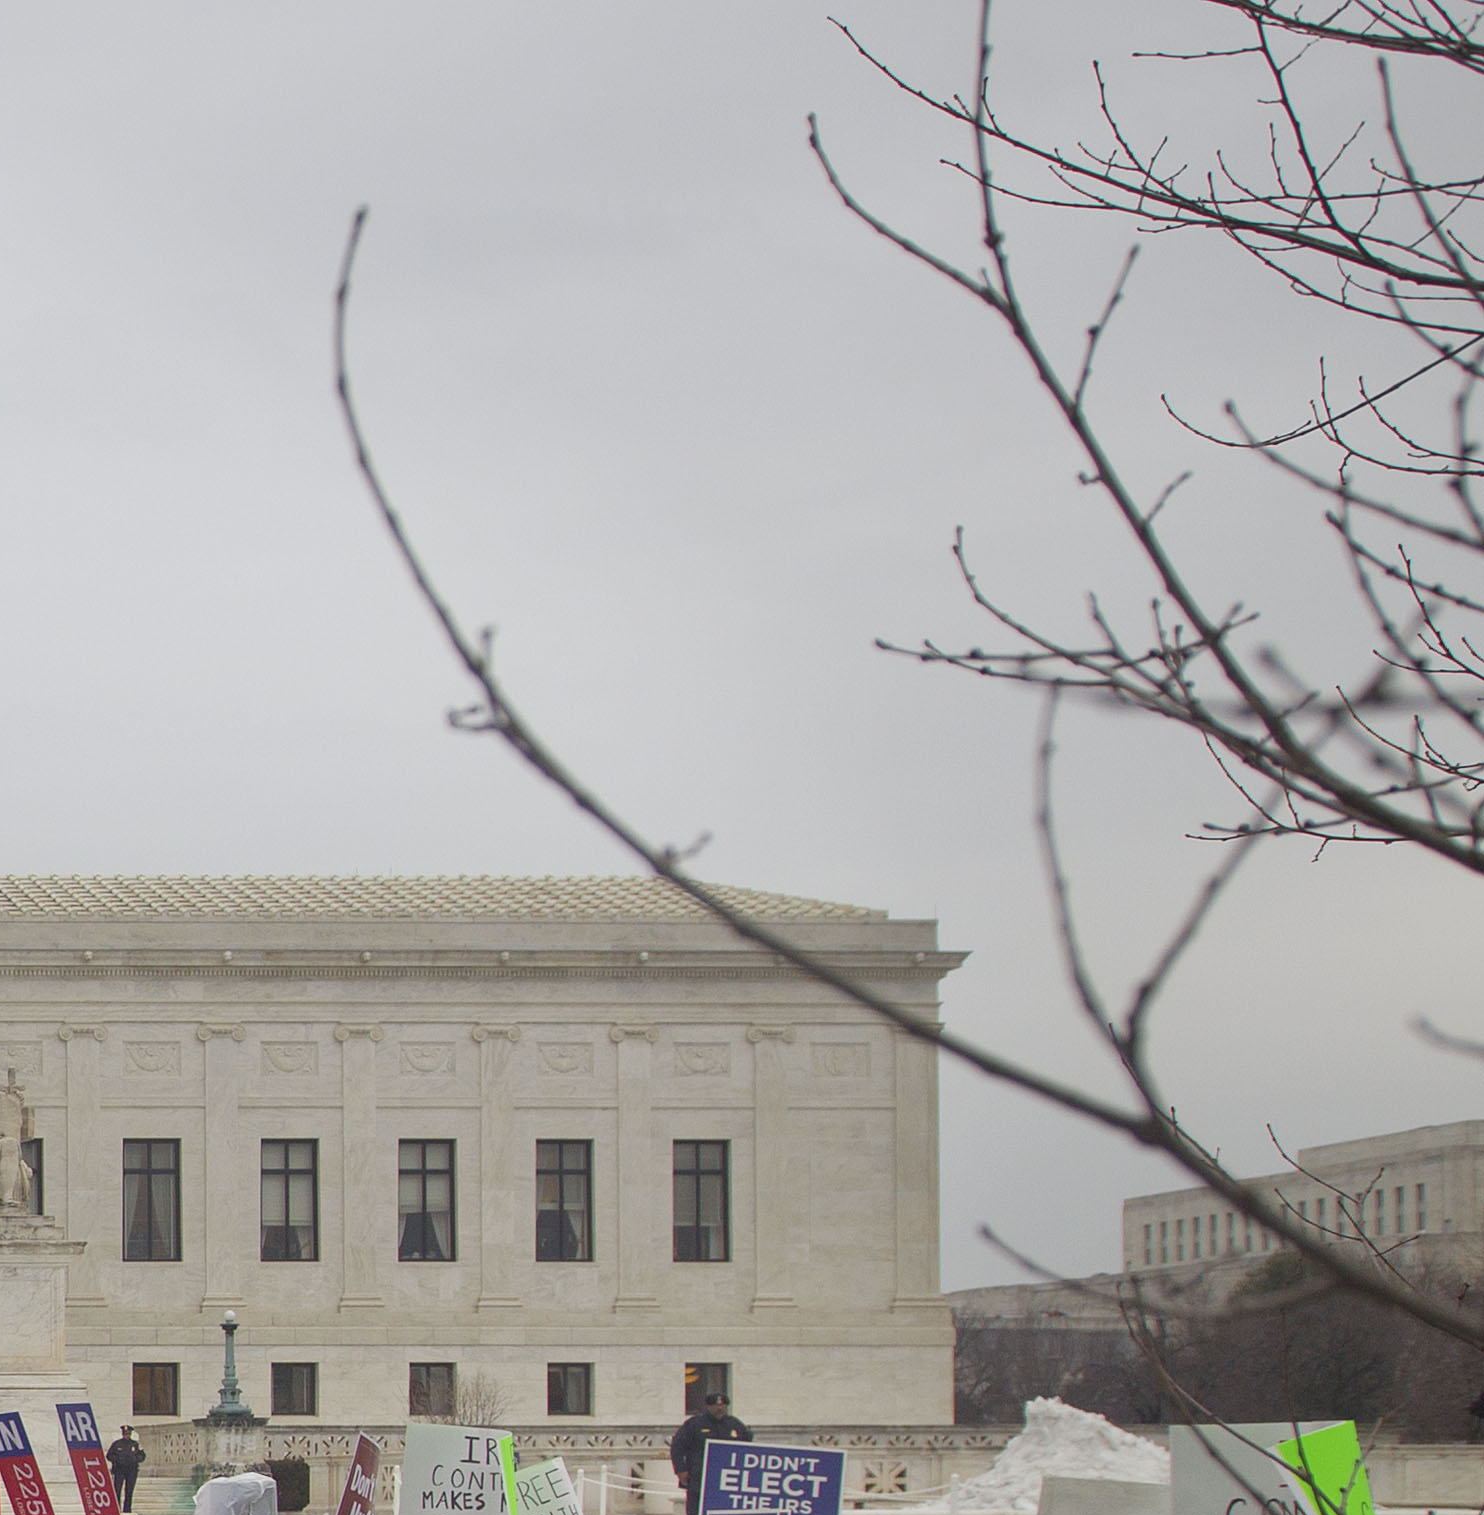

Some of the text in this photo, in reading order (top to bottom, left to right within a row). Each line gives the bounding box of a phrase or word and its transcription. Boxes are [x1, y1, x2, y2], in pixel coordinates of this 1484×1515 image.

[64, 1412, 97, 1442] AR
[460, 1436, 501, 1466] IR
[731, 1452, 820, 1473] I DIDN'T
[516, 1468, 570, 1510] REE
[719, 1469, 828, 1498] ELECT
[422, 1491, 486, 1511] MAKES
[729, 1494, 813, 1515] THE IRS
